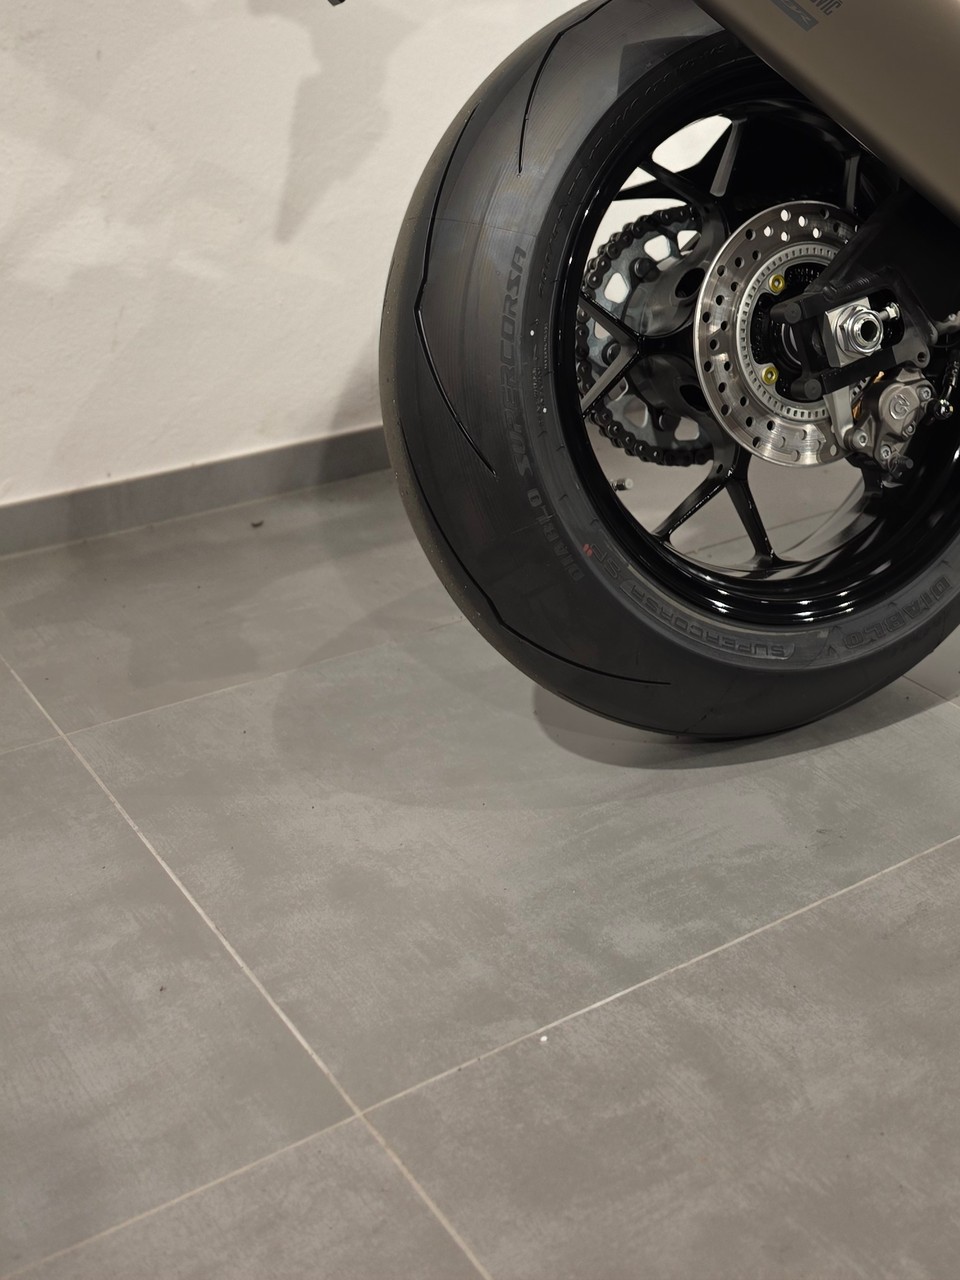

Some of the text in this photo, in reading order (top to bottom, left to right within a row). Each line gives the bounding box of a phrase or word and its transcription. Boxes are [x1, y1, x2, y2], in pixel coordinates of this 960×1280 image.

[499, 244, 533, 477] SUPERCORSA
[526, 487, 585, 583] DIABLO
[629, 584, 785, 657] SUPERCORSA
[843, 575, 951, 650] DIABLO
